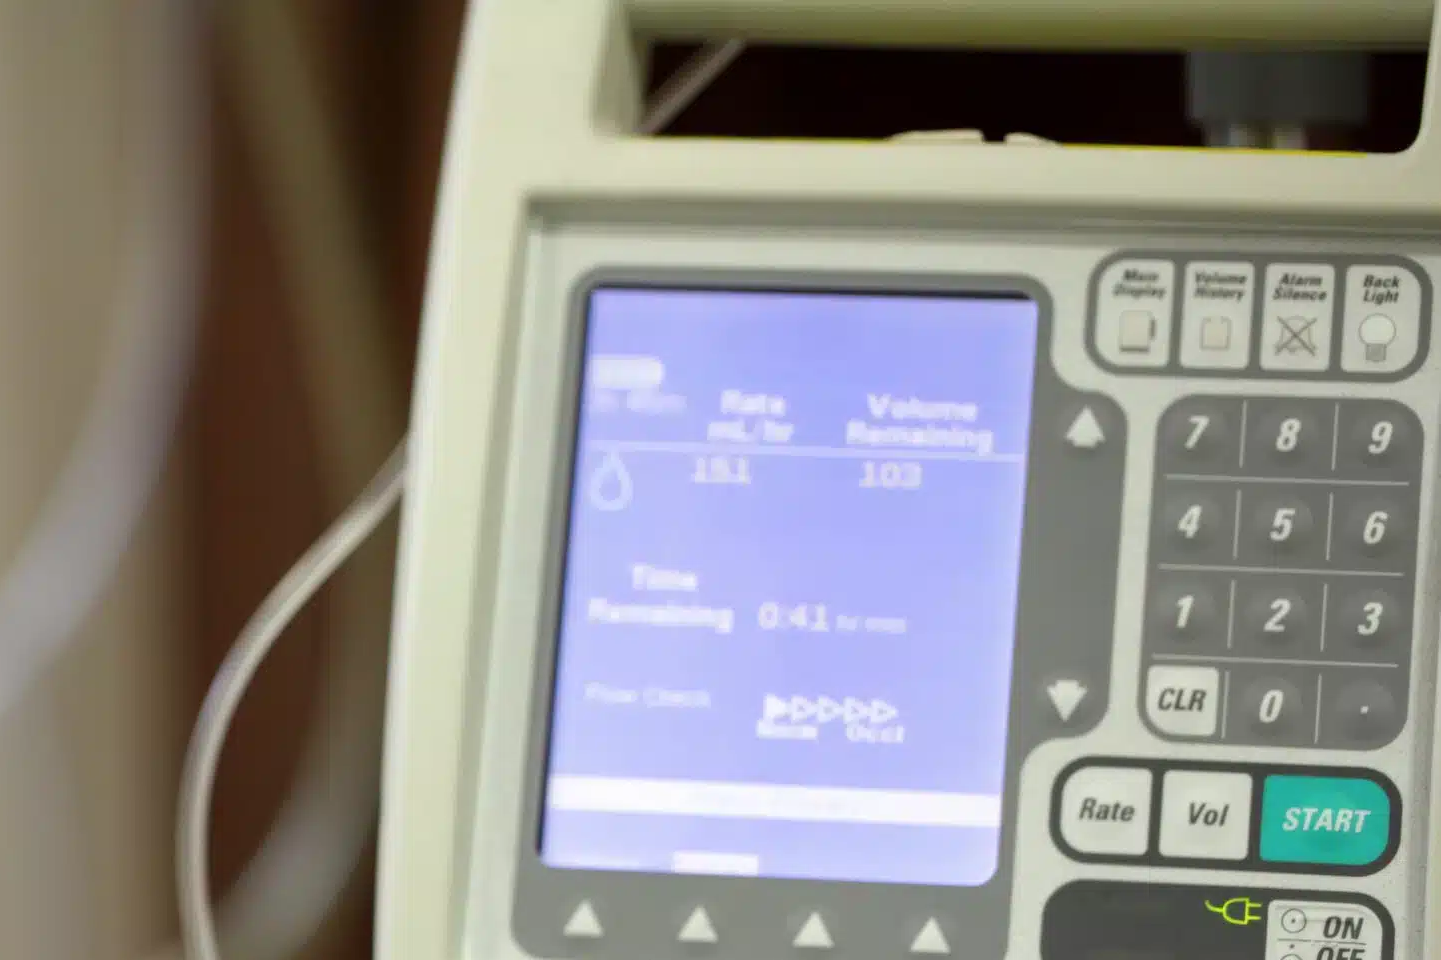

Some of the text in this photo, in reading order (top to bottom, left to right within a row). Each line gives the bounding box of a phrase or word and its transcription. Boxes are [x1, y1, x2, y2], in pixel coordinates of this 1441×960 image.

[1123, 268, 1159, 281] Main
[1195, 271, 1247, 284] Volume
[1280, 272, 1323, 286] Alarm
[1363, 273, 1400, 288] Back
[1112, 283, 1165, 300] Display
[1195, 286, 1245, 302] History
[1273, 286, 1327, 301] Silence
[1363, 289, 1400, 305] Light
[720, 389, 786, 416] Rate
[867, 392, 977, 422] Volume
[846, 419, 993, 456] Remaining
[1184, 415, 1209, 449] 7
[1275, 418, 1301, 452] 8
[1368, 421, 1393, 454] 9
[691, 456, 751, 486] 151
[859, 461, 923, 489] 103
[1178, 504, 1202, 538] 4
[1270, 508, 1296, 542] 5
[1363, 511, 1389, 544] 6
[632, 564, 697, 592] Time
[758, 602, 829, 632] 0:41
[1176, 595, 1194, 628] 1
[1264, 598, 1291, 632] 2
[1358, 602, 1383, 635] 3
[1158, 687, 1207, 712] CLR
[1258, 689, 1284, 723] 0
[1079, 797, 1135, 823] Rate
[1188, 802, 1230, 828] Vol
[1282, 807, 1371, 834] START
[1323, 916, 1364, 940] ON
